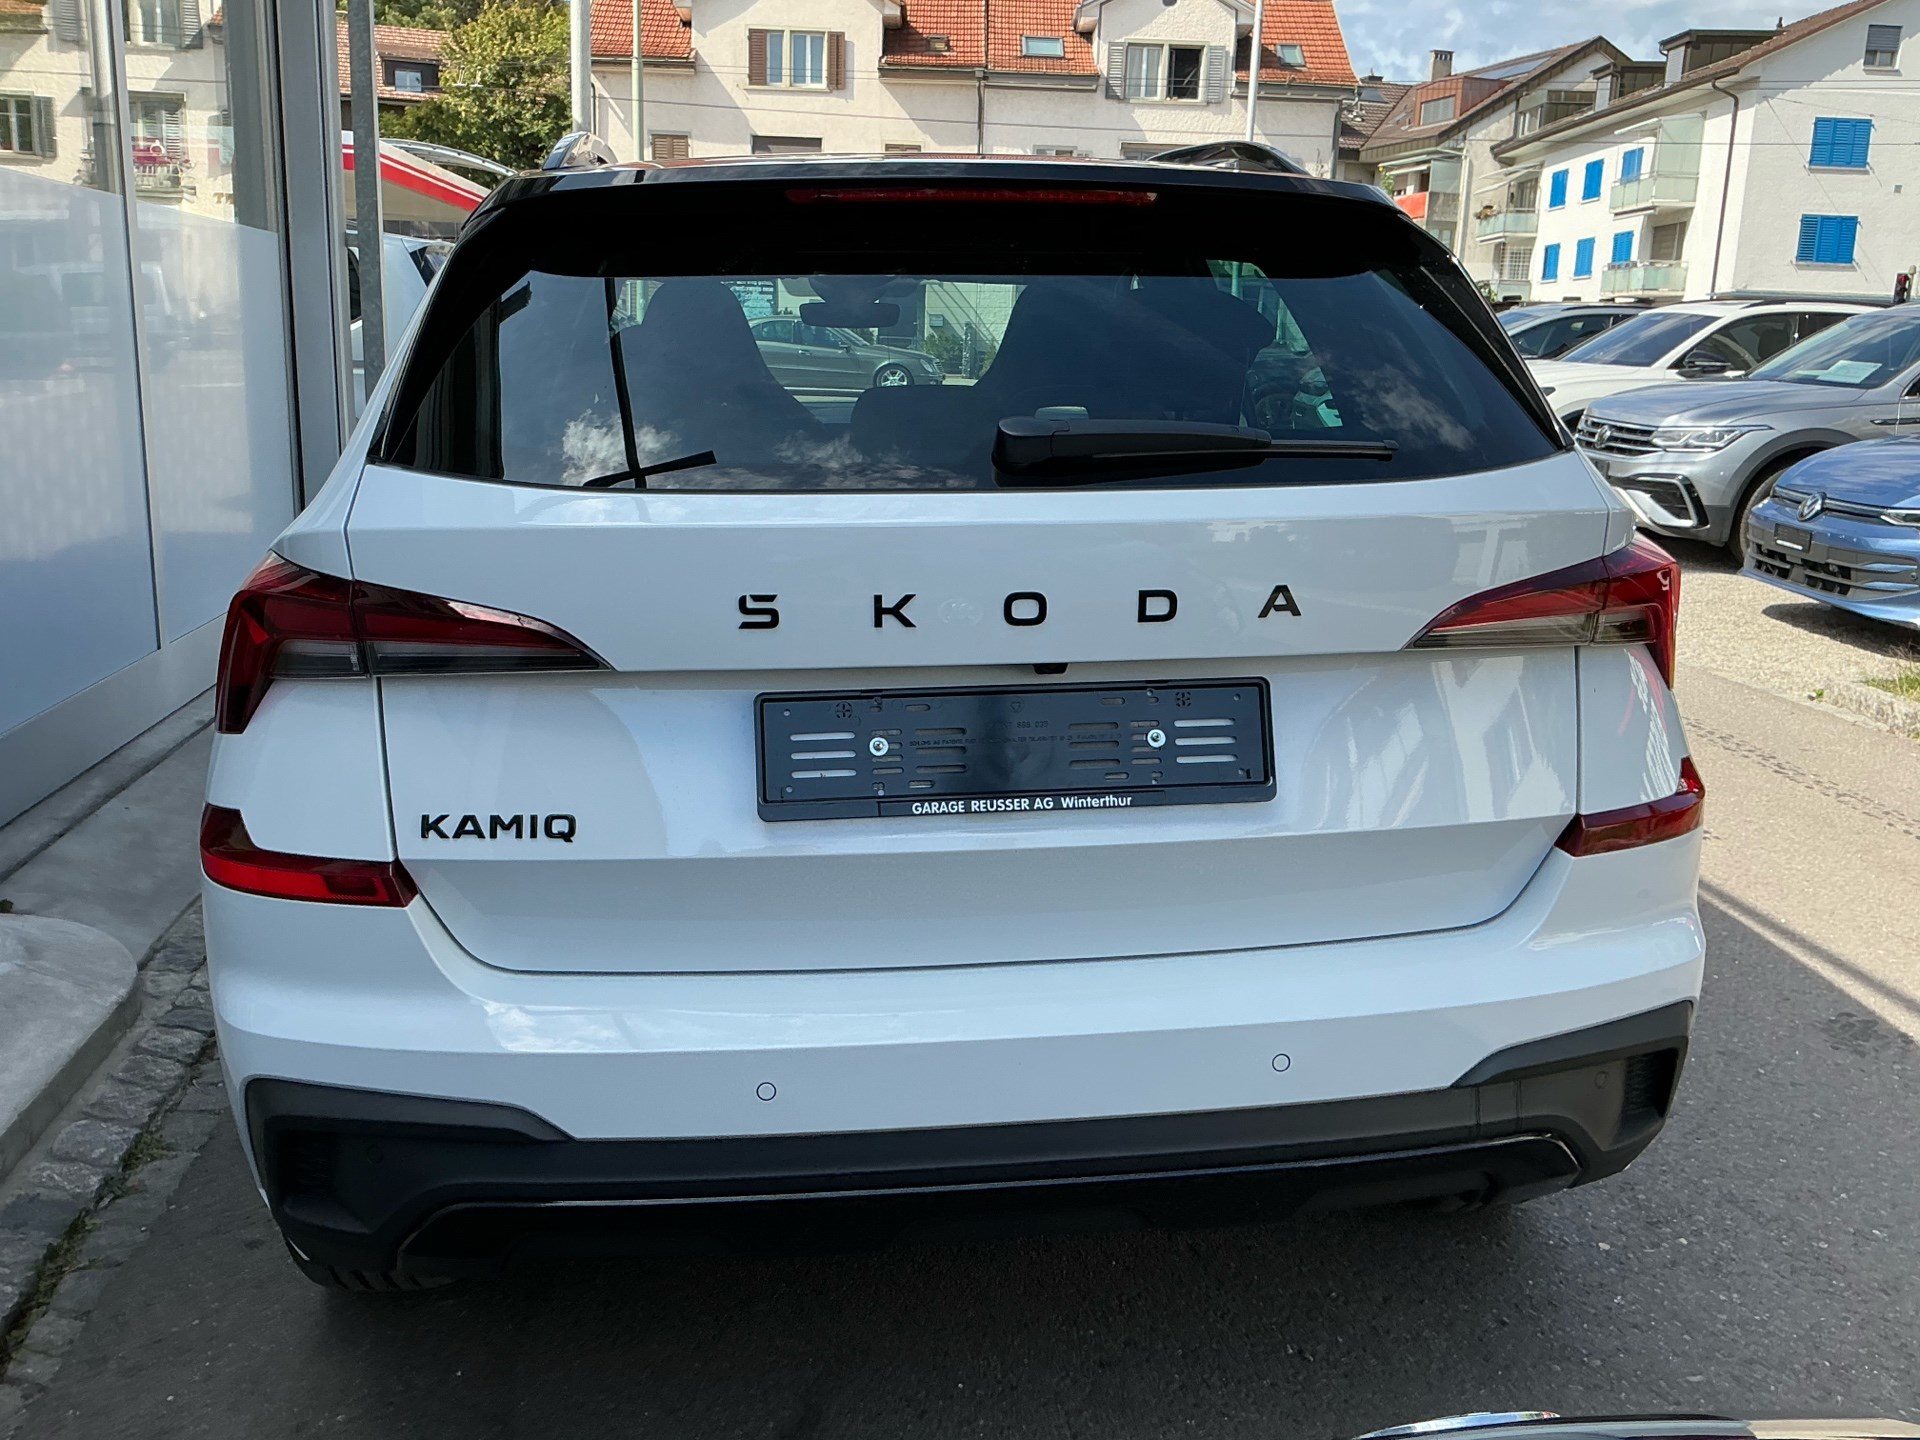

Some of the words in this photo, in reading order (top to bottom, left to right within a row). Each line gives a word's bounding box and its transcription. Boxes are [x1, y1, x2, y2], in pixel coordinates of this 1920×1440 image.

[737, 584, 1302, 630] SKODA
[911, 800, 966, 815] GARAGE
[970, 797, 1030, 812] REUSSER
[1033, 796, 1054, 811] AG
[1060, 794, 1133, 809] Winterthur
[420, 813, 577, 843] KAMIQ
